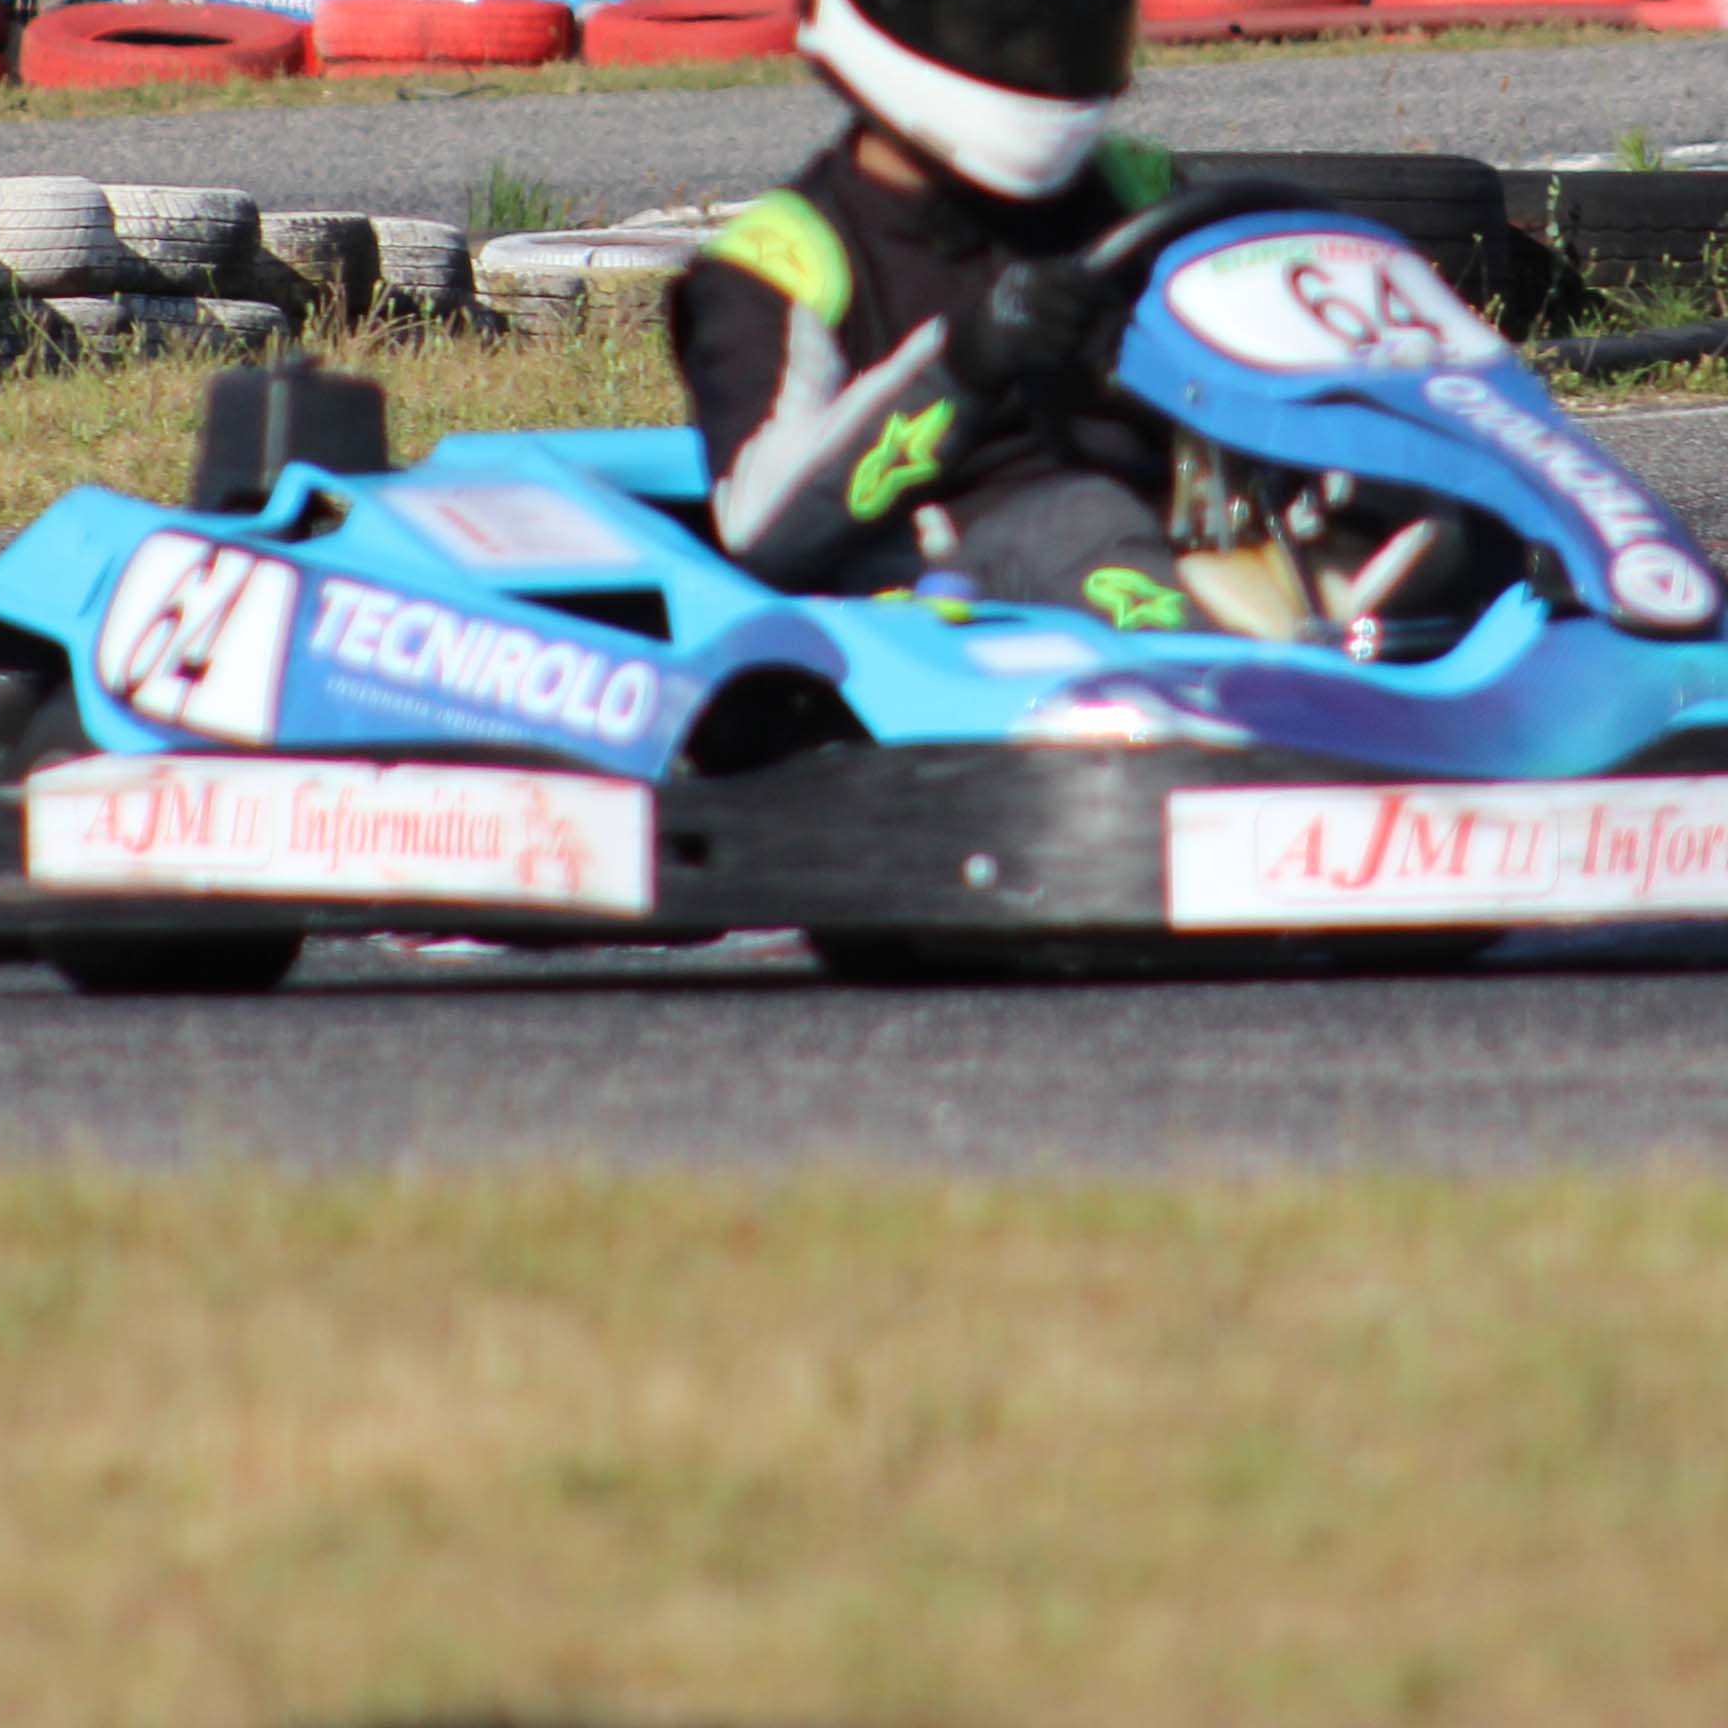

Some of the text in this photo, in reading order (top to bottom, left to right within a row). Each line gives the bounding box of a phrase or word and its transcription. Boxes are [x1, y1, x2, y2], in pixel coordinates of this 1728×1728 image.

[1282, 256, 1450, 352] 64
[118, 542, 258, 724] 64
[309, 576, 660, 741] TECNIROLO
[83, 763, 218, 854] AJM
[288, 779, 503, 874] Informática
[1266, 790, 1480, 891] AJM
